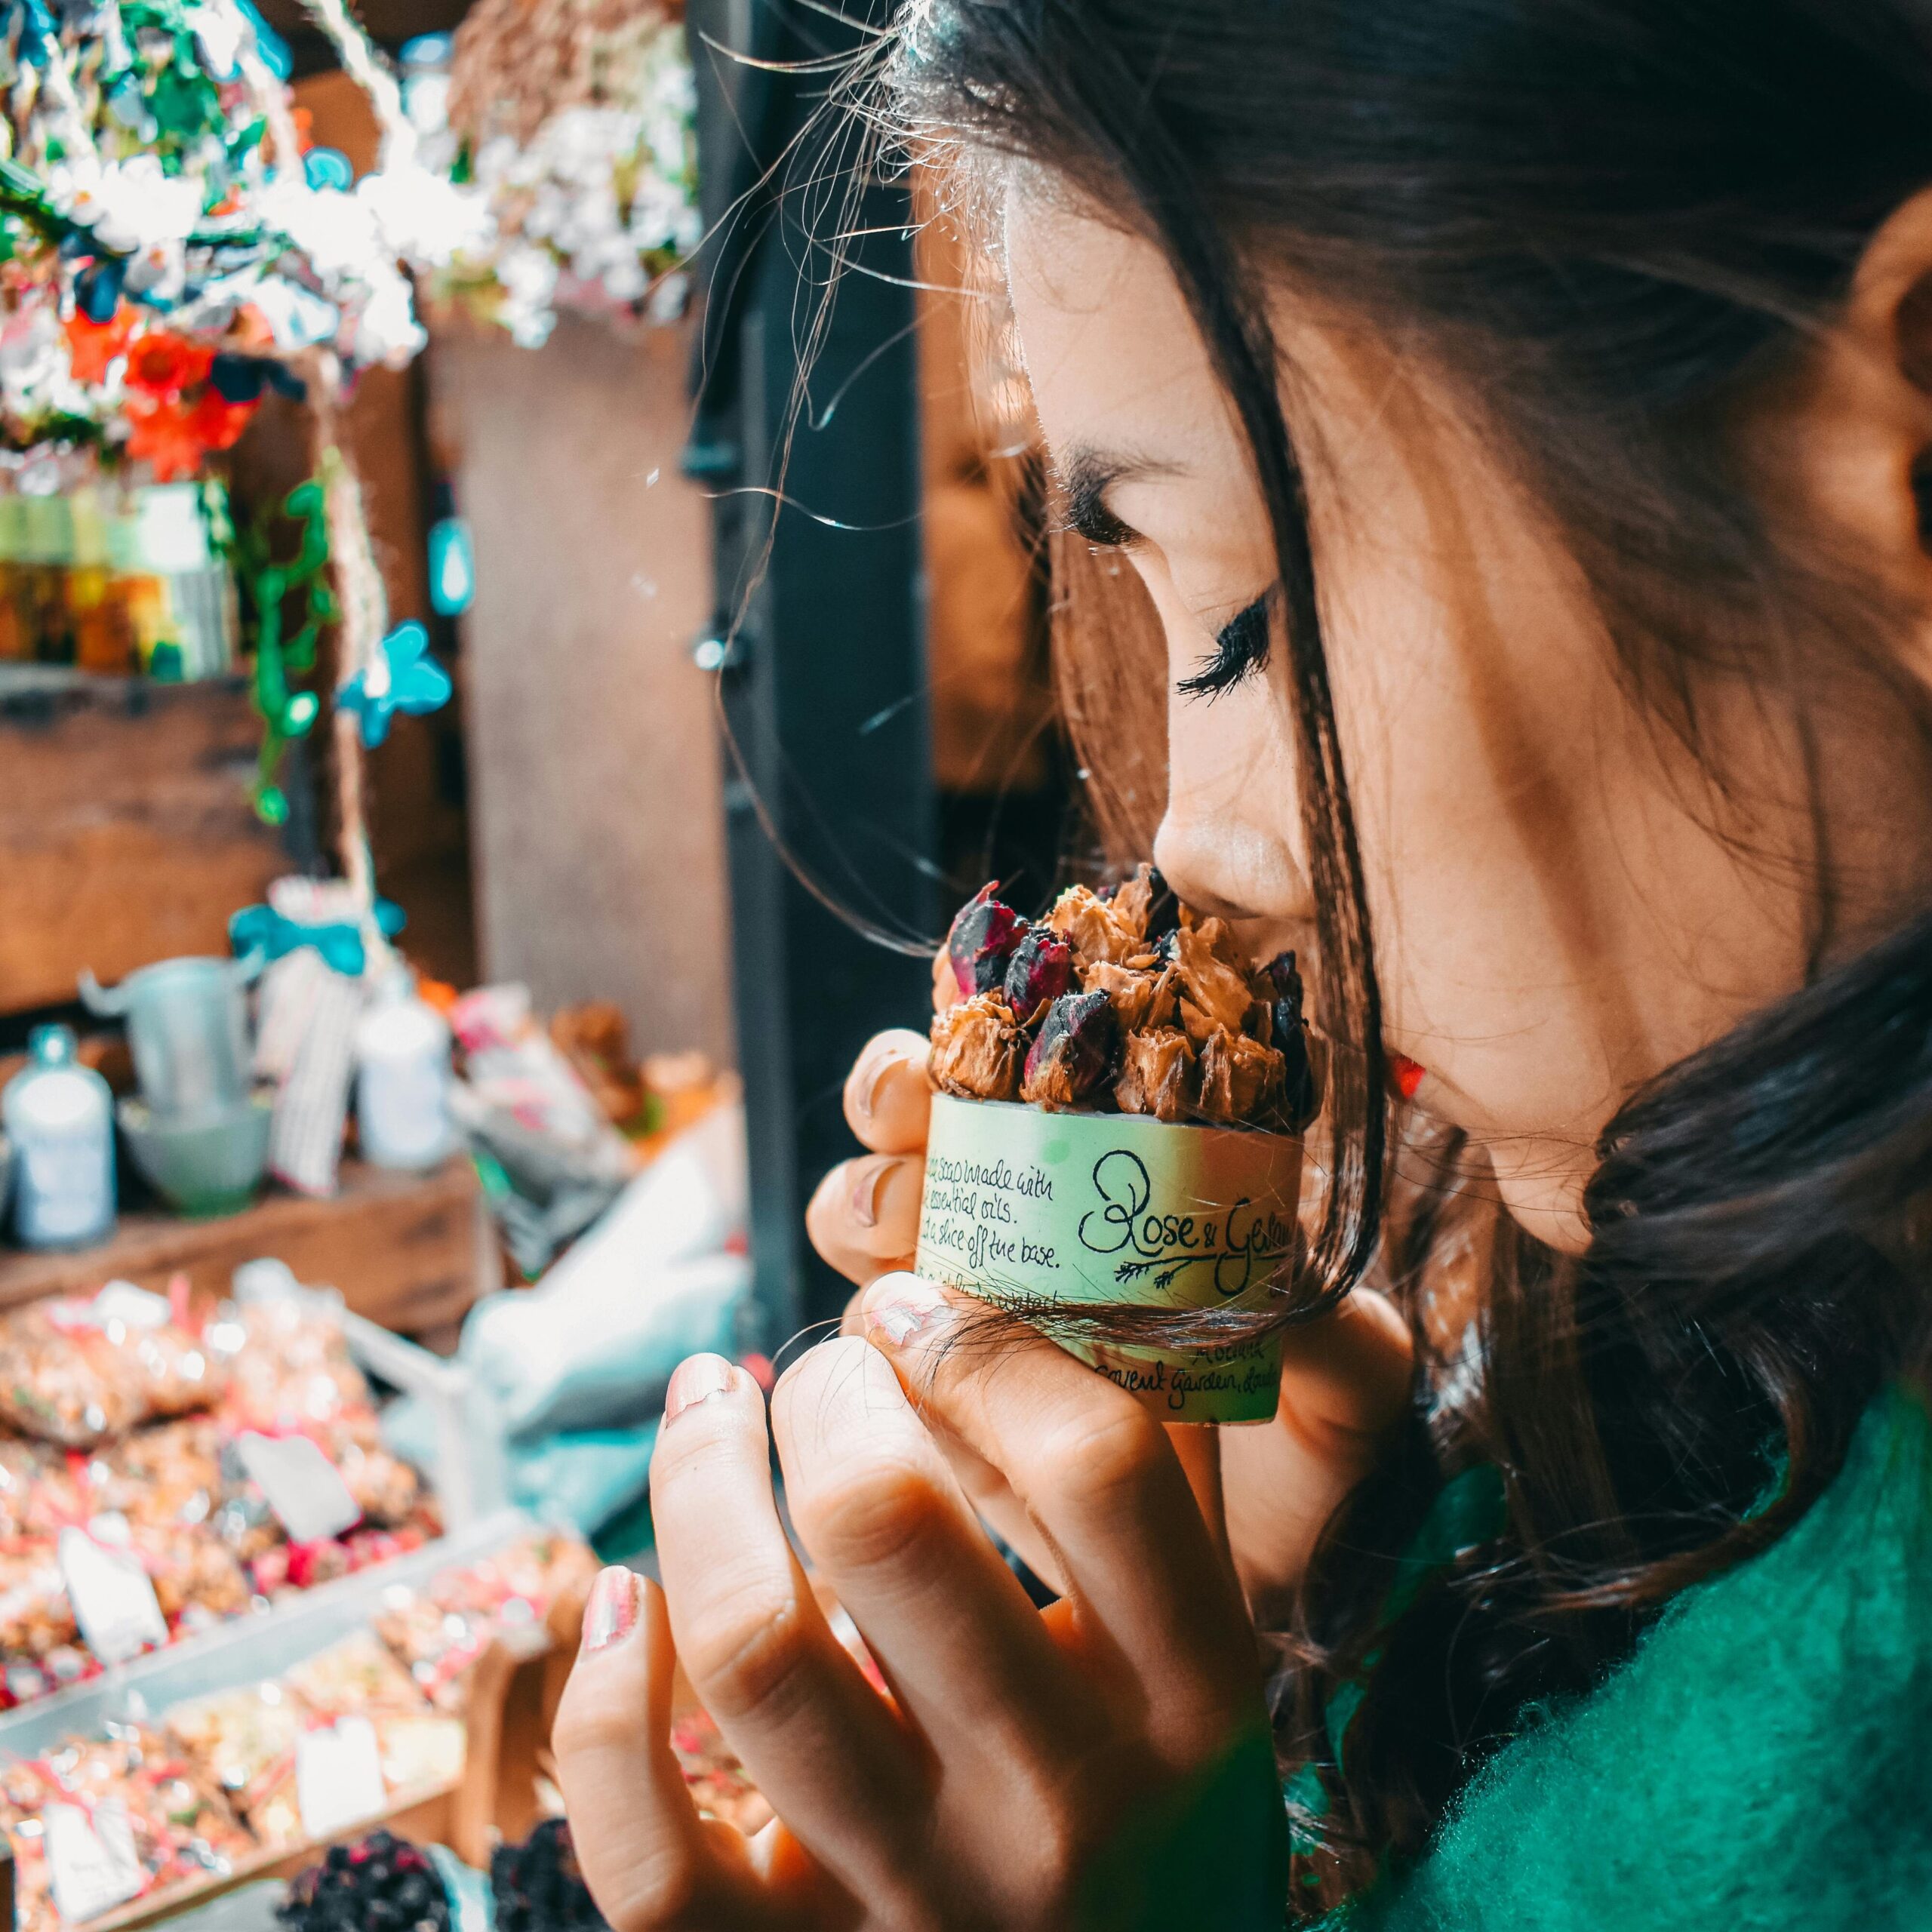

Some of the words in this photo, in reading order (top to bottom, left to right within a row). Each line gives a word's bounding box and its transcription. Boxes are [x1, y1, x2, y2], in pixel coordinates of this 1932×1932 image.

[964, 1159, 1014, 1190] made
[1017, 1166, 1054, 1201] with
[930, 1188, 977, 1220] essential
[981, 1193, 1017, 1223] oils.
[1078, 1149, 1199, 1257] Rose
[1203, 1217, 1217, 1246] &
[968, 1224, 989, 1269] off
[1021, 1236, 1060, 1269] base.
